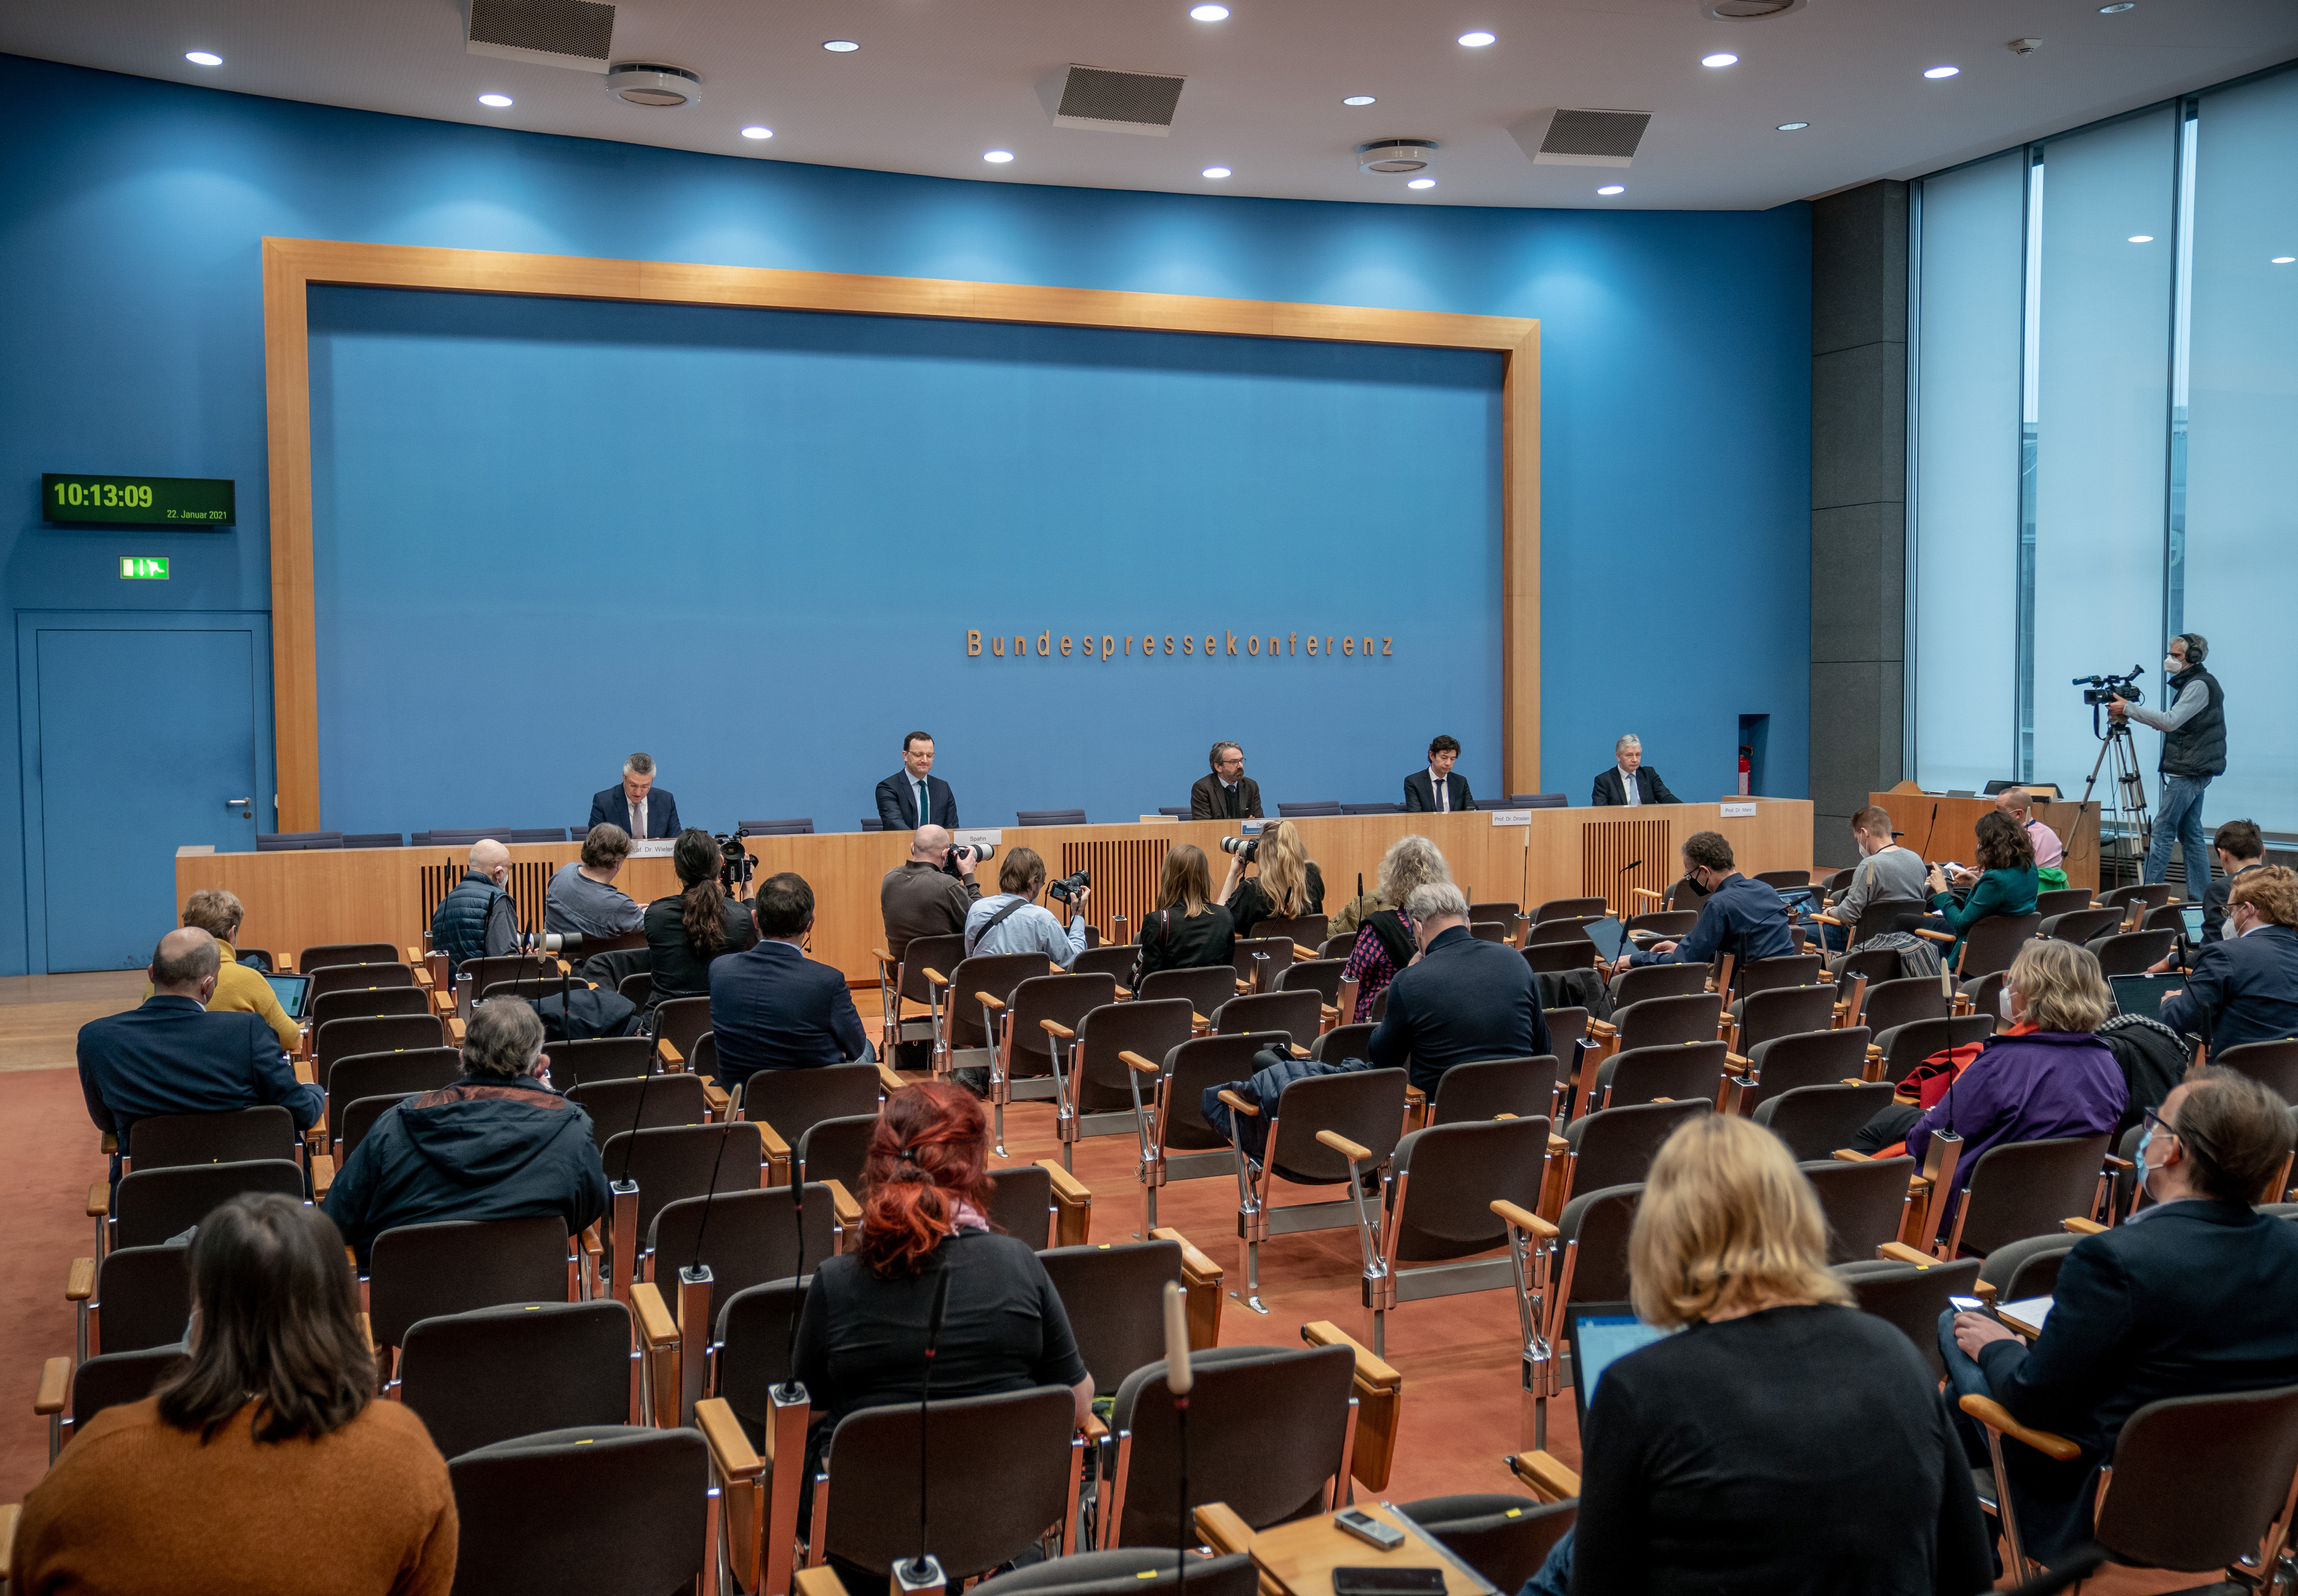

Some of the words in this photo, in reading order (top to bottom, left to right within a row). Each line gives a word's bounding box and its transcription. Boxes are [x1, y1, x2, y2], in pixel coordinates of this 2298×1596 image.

[54, 483, 152, 508] 10:13:09
[167, 510, 178, 518] 22.
[181, 510, 207, 519] Januar
[209, 511, 226, 519] 2021
[967, 629, 1392, 662] Bundespressekonferenz
